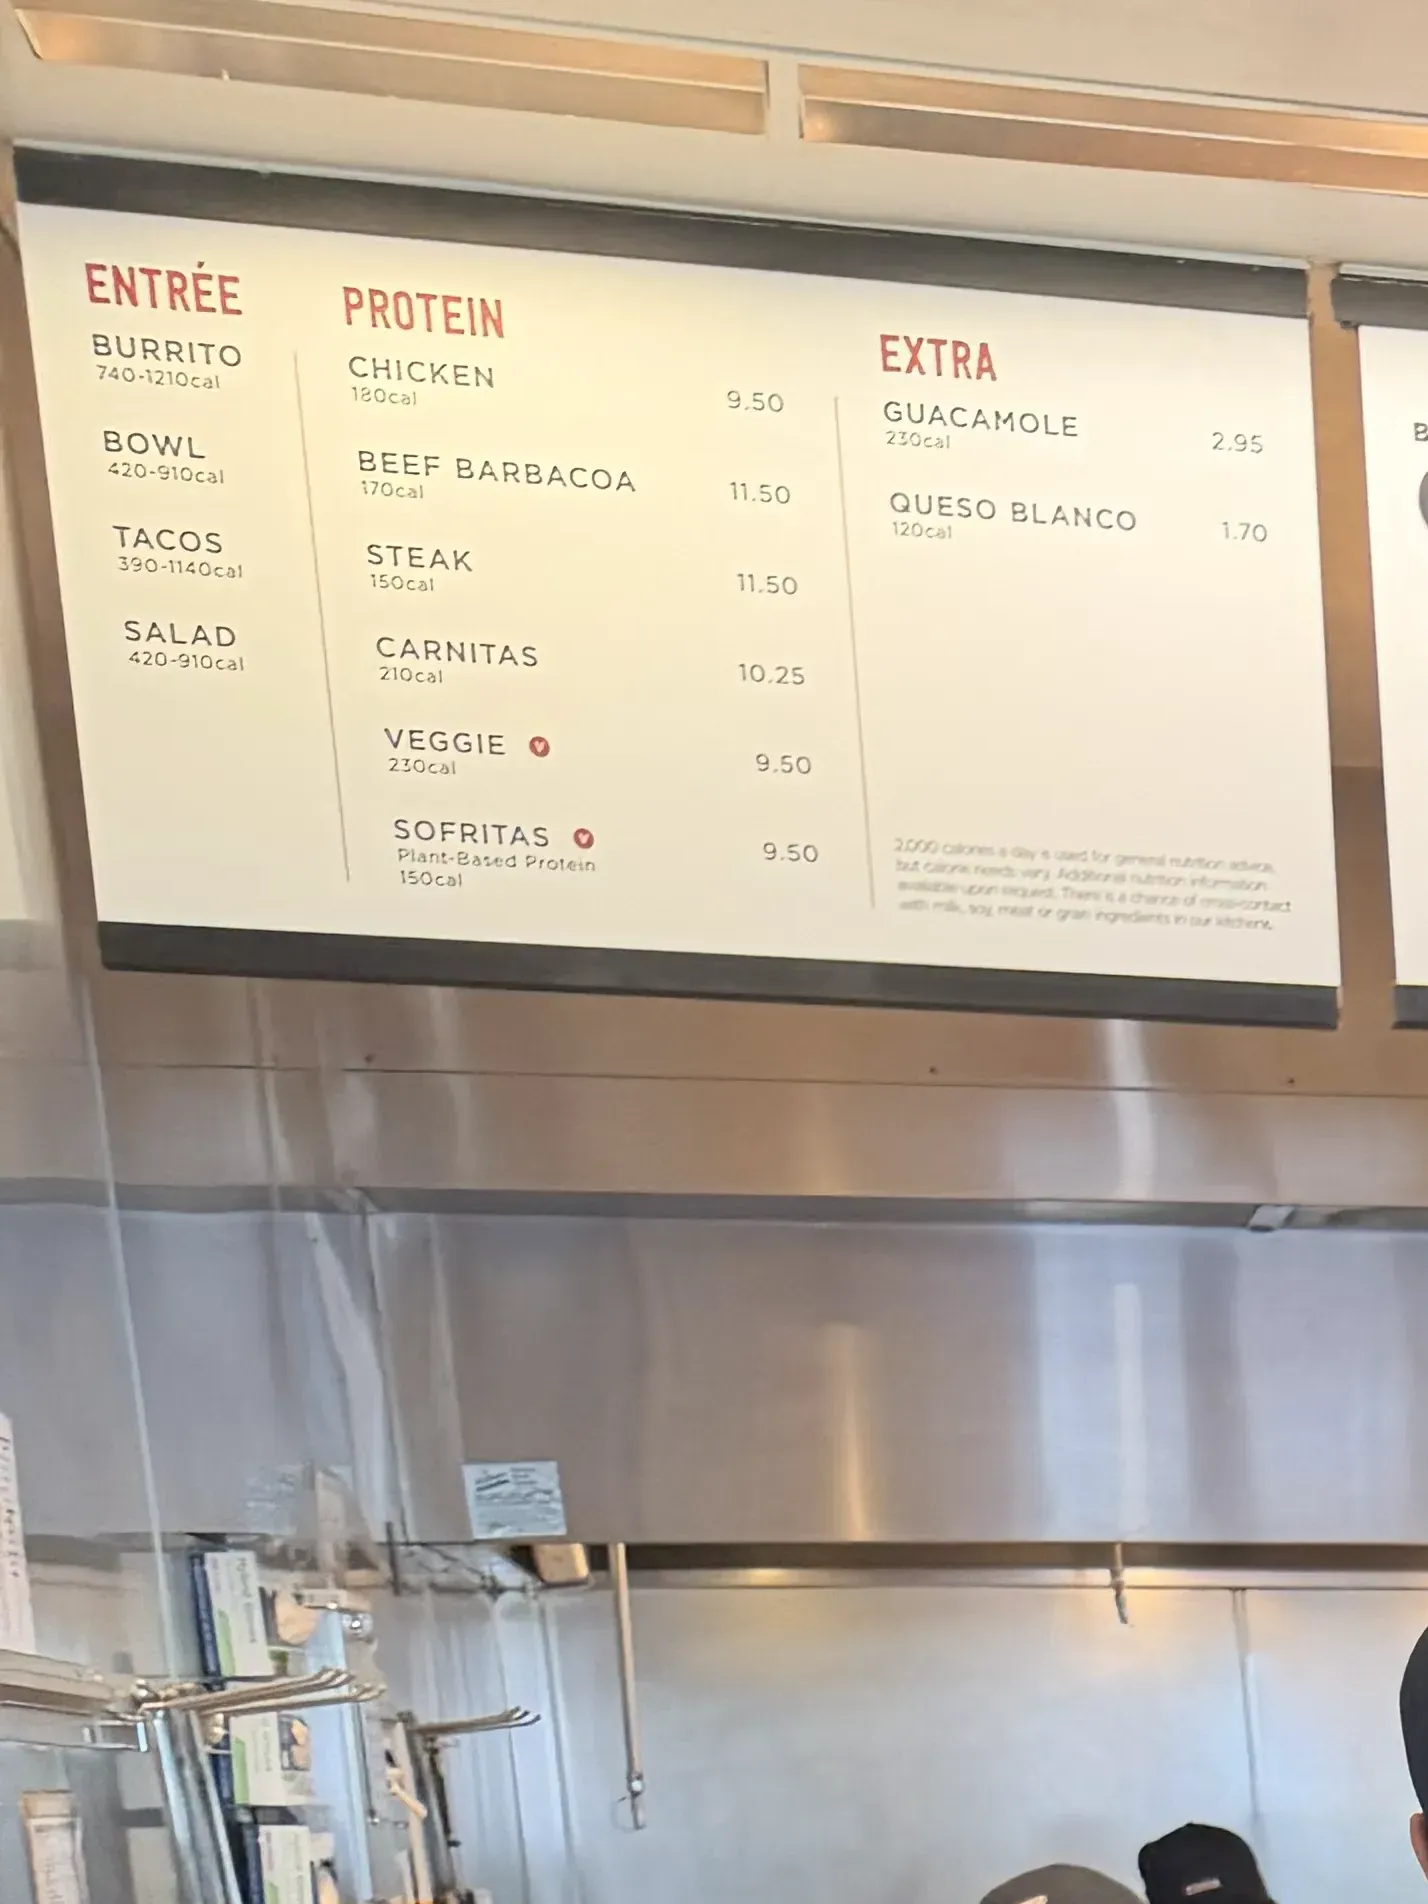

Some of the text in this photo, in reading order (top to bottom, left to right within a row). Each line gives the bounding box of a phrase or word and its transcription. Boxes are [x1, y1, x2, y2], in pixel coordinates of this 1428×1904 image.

[84, 261, 243, 316] ENTRÉE
[343, 286, 505, 338] PROTEIN
[92, 333, 242, 367] BURRITO
[879, 333, 998, 383] EXTRA
[96, 364, 220, 390] 740-1210cal
[349, 356, 495, 388] CHICKEN
[726, 388, 785, 414] 9.50
[883, 400, 1079, 438] GUACAMOLE
[103, 431, 207, 459] BOWL
[886, 431, 951, 451] 230cal
[1211, 431, 1264, 455] 2.95
[108, 462, 225, 485] 420-910cal
[358, 450, 636, 492] BEEF BARBACOA
[361, 480, 424, 499] 170cal
[729, 482, 791, 506] 11.50
[890, 492, 1138, 532] QUESO BLANCO
[112, 525, 222, 554] TACOS
[892, 522, 953, 541] 120cal
[1221, 520, 1268, 544] 1.70
[118, 556, 243, 579] 390-1140cal
[367, 544, 473, 572] STEAK
[370, 574, 434, 591] 150cal
[736, 572, 799, 597] 11.50
[124, 620, 236, 647] SALAD
[128, 651, 244, 671] 420-910cal
[376, 637, 538, 667] CARNITAS
[380, 666, 443, 683] 210cal
[738, 663, 806, 688] 10.25
[384, 727, 506, 755] VEGGIE
[388, 758, 456, 775] 230cal
[755, 753, 812, 776] 9.50
[393, 819, 549, 847] SOFRITAS
[398, 848, 596, 872] Plant-Based Protein
[762, 841, 819, 864] 9.50
[400, 870, 462, 887] 150cal
